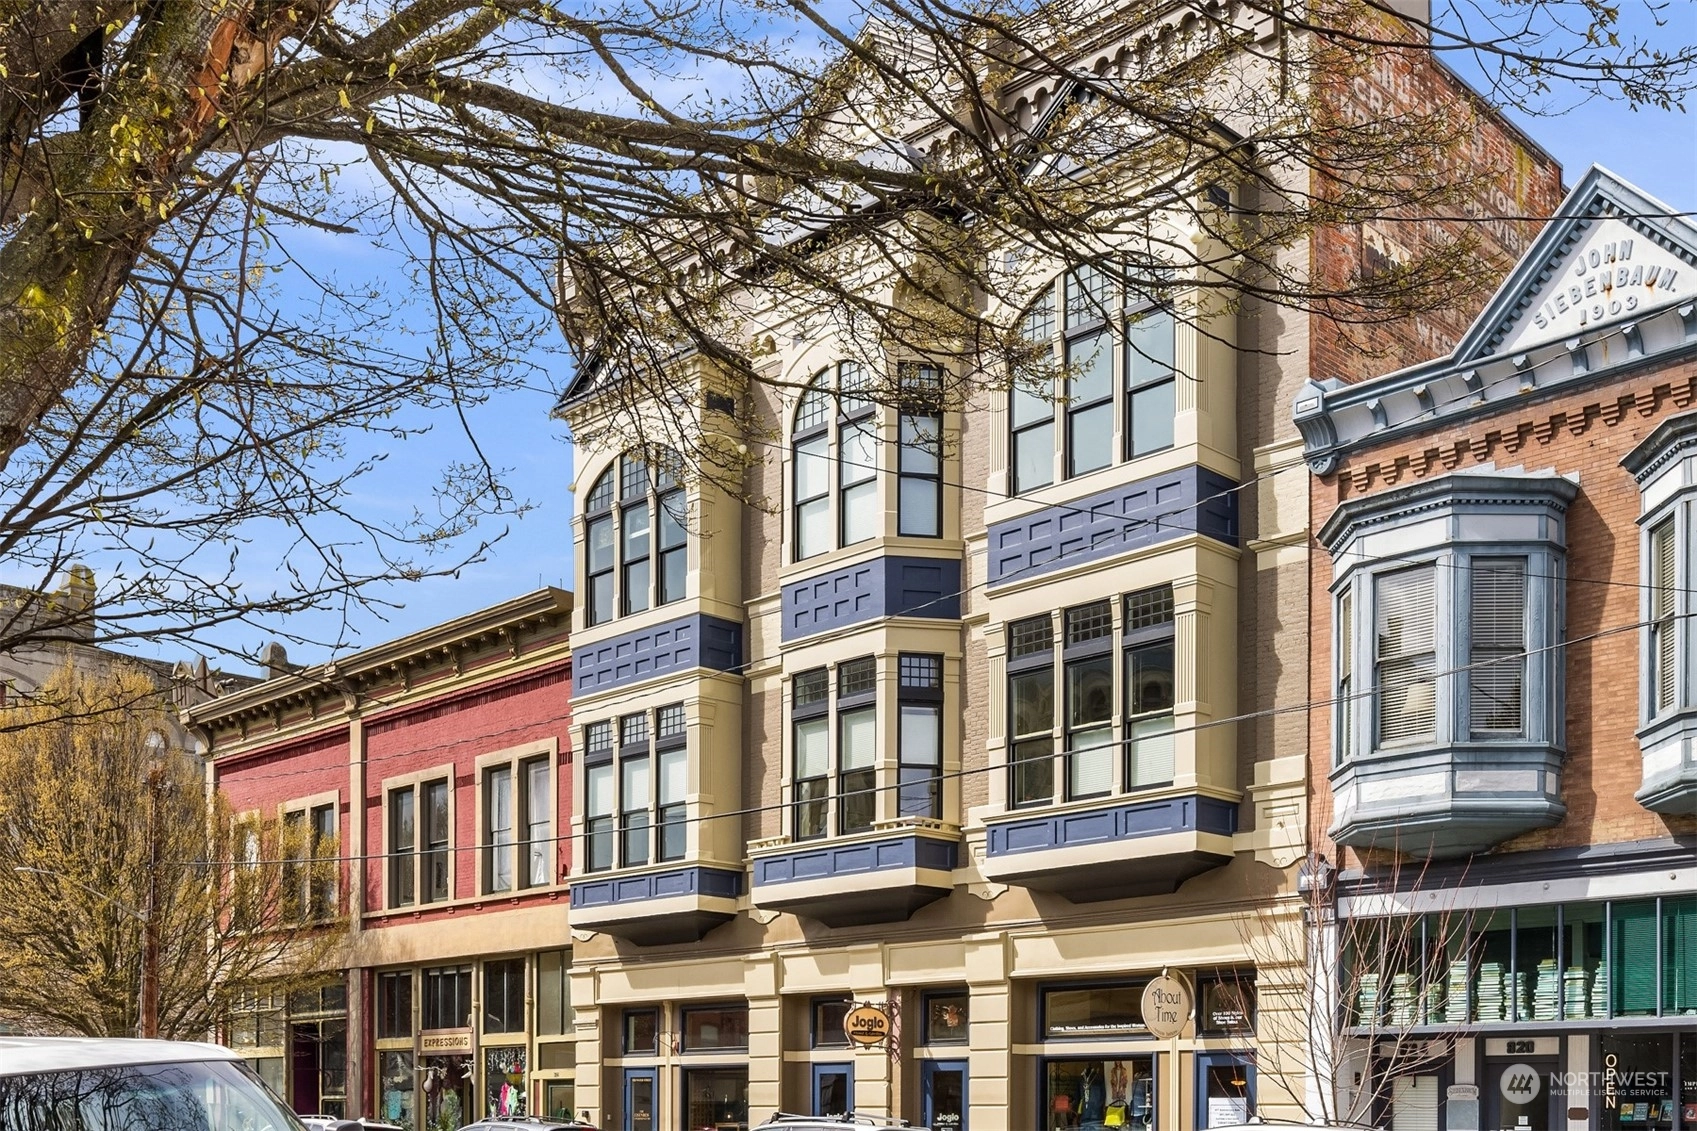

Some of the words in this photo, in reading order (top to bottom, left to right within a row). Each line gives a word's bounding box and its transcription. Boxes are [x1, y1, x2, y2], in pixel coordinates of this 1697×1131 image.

[1574, 239, 1633, 277] JOHN
[1580, 294, 1638, 325] 1903
[1152, 988, 1182, 1006] About
[852, 1015, 884, 1031] Joglo
[1155, 1005, 1178, 1024] Time
[423, 1036, 468, 1048] EXPRESSIONS
[1605, 1053, 1617, 1109] OPEN
[936, 1112, 960, 1123] Joglo
